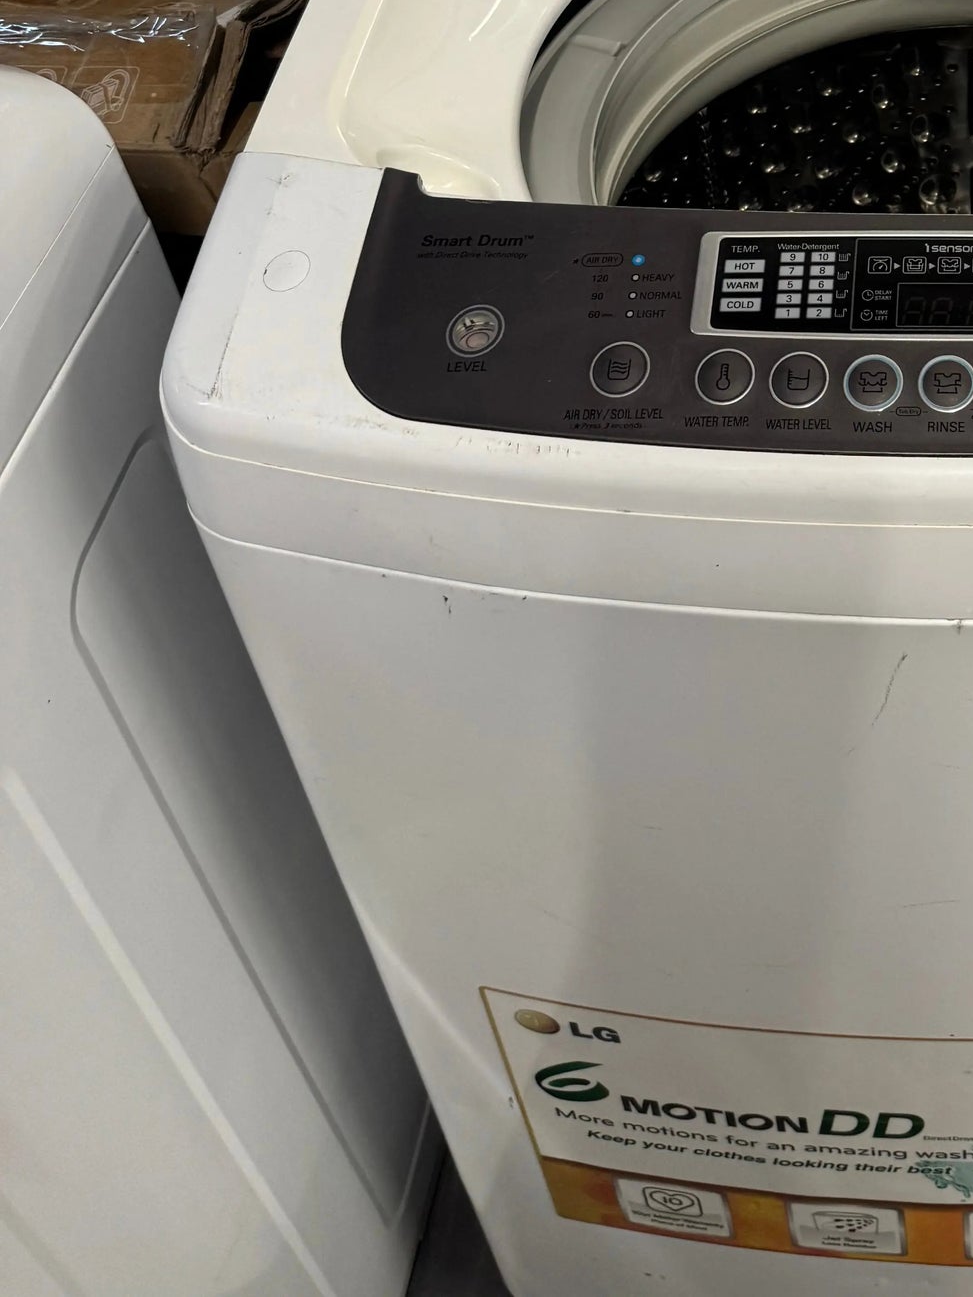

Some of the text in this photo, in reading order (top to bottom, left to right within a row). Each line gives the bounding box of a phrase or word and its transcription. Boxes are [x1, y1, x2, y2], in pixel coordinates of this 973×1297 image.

[421, 234, 472, 247] Smart
[731, 245, 760, 253] TEMP.
[586, 256, 619, 264] AIR DRY
[789, 253, 796, 261] 9
[818, 253, 829, 261] 10
[734, 262, 755, 271] HOT
[789, 267, 795, 275] 7
[819, 267, 826, 275] 8
[642, 273, 675, 282] HEAVY
[726, 281, 759, 290] WARM
[787, 281, 794, 289] 5
[818, 281, 825, 289] 6
[591, 292, 604, 301] 90
[640, 291, 682, 300] NORMAL
[786, 295, 792, 303] 3
[816, 295, 823, 303] 4
[727, 301, 754, 309] COLD
[588, 310, 600, 319] 60
[636, 309, 666, 319] LIGHT
[816, 309, 822, 317] 2
[446, 361, 487, 372] LEVEL
[563, 409, 580, 420] AIR
[634, 408, 664, 420] LEVEL
[684, 416, 749, 427] WATER TEMP.
[766, 418, 832, 430] WATER LEVEL
[852, 421, 893, 433] WASH
[927, 421, 966, 433] RINSE
[569, 1021, 622, 1044] LG
[620, 1094, 809, 1134] MOTION
[818, 1109, 925, 1140] DD
[554, 1107, 614, 1128] More
[623, 1121, 718, 1143] motions
[725, 1134, 758, 1149] for
[767, 1141, 796, 1152] an
[804, 1144, 908, 1160] amazing
[587, 1130, 952, 1175] Keep your clothes looking their best
